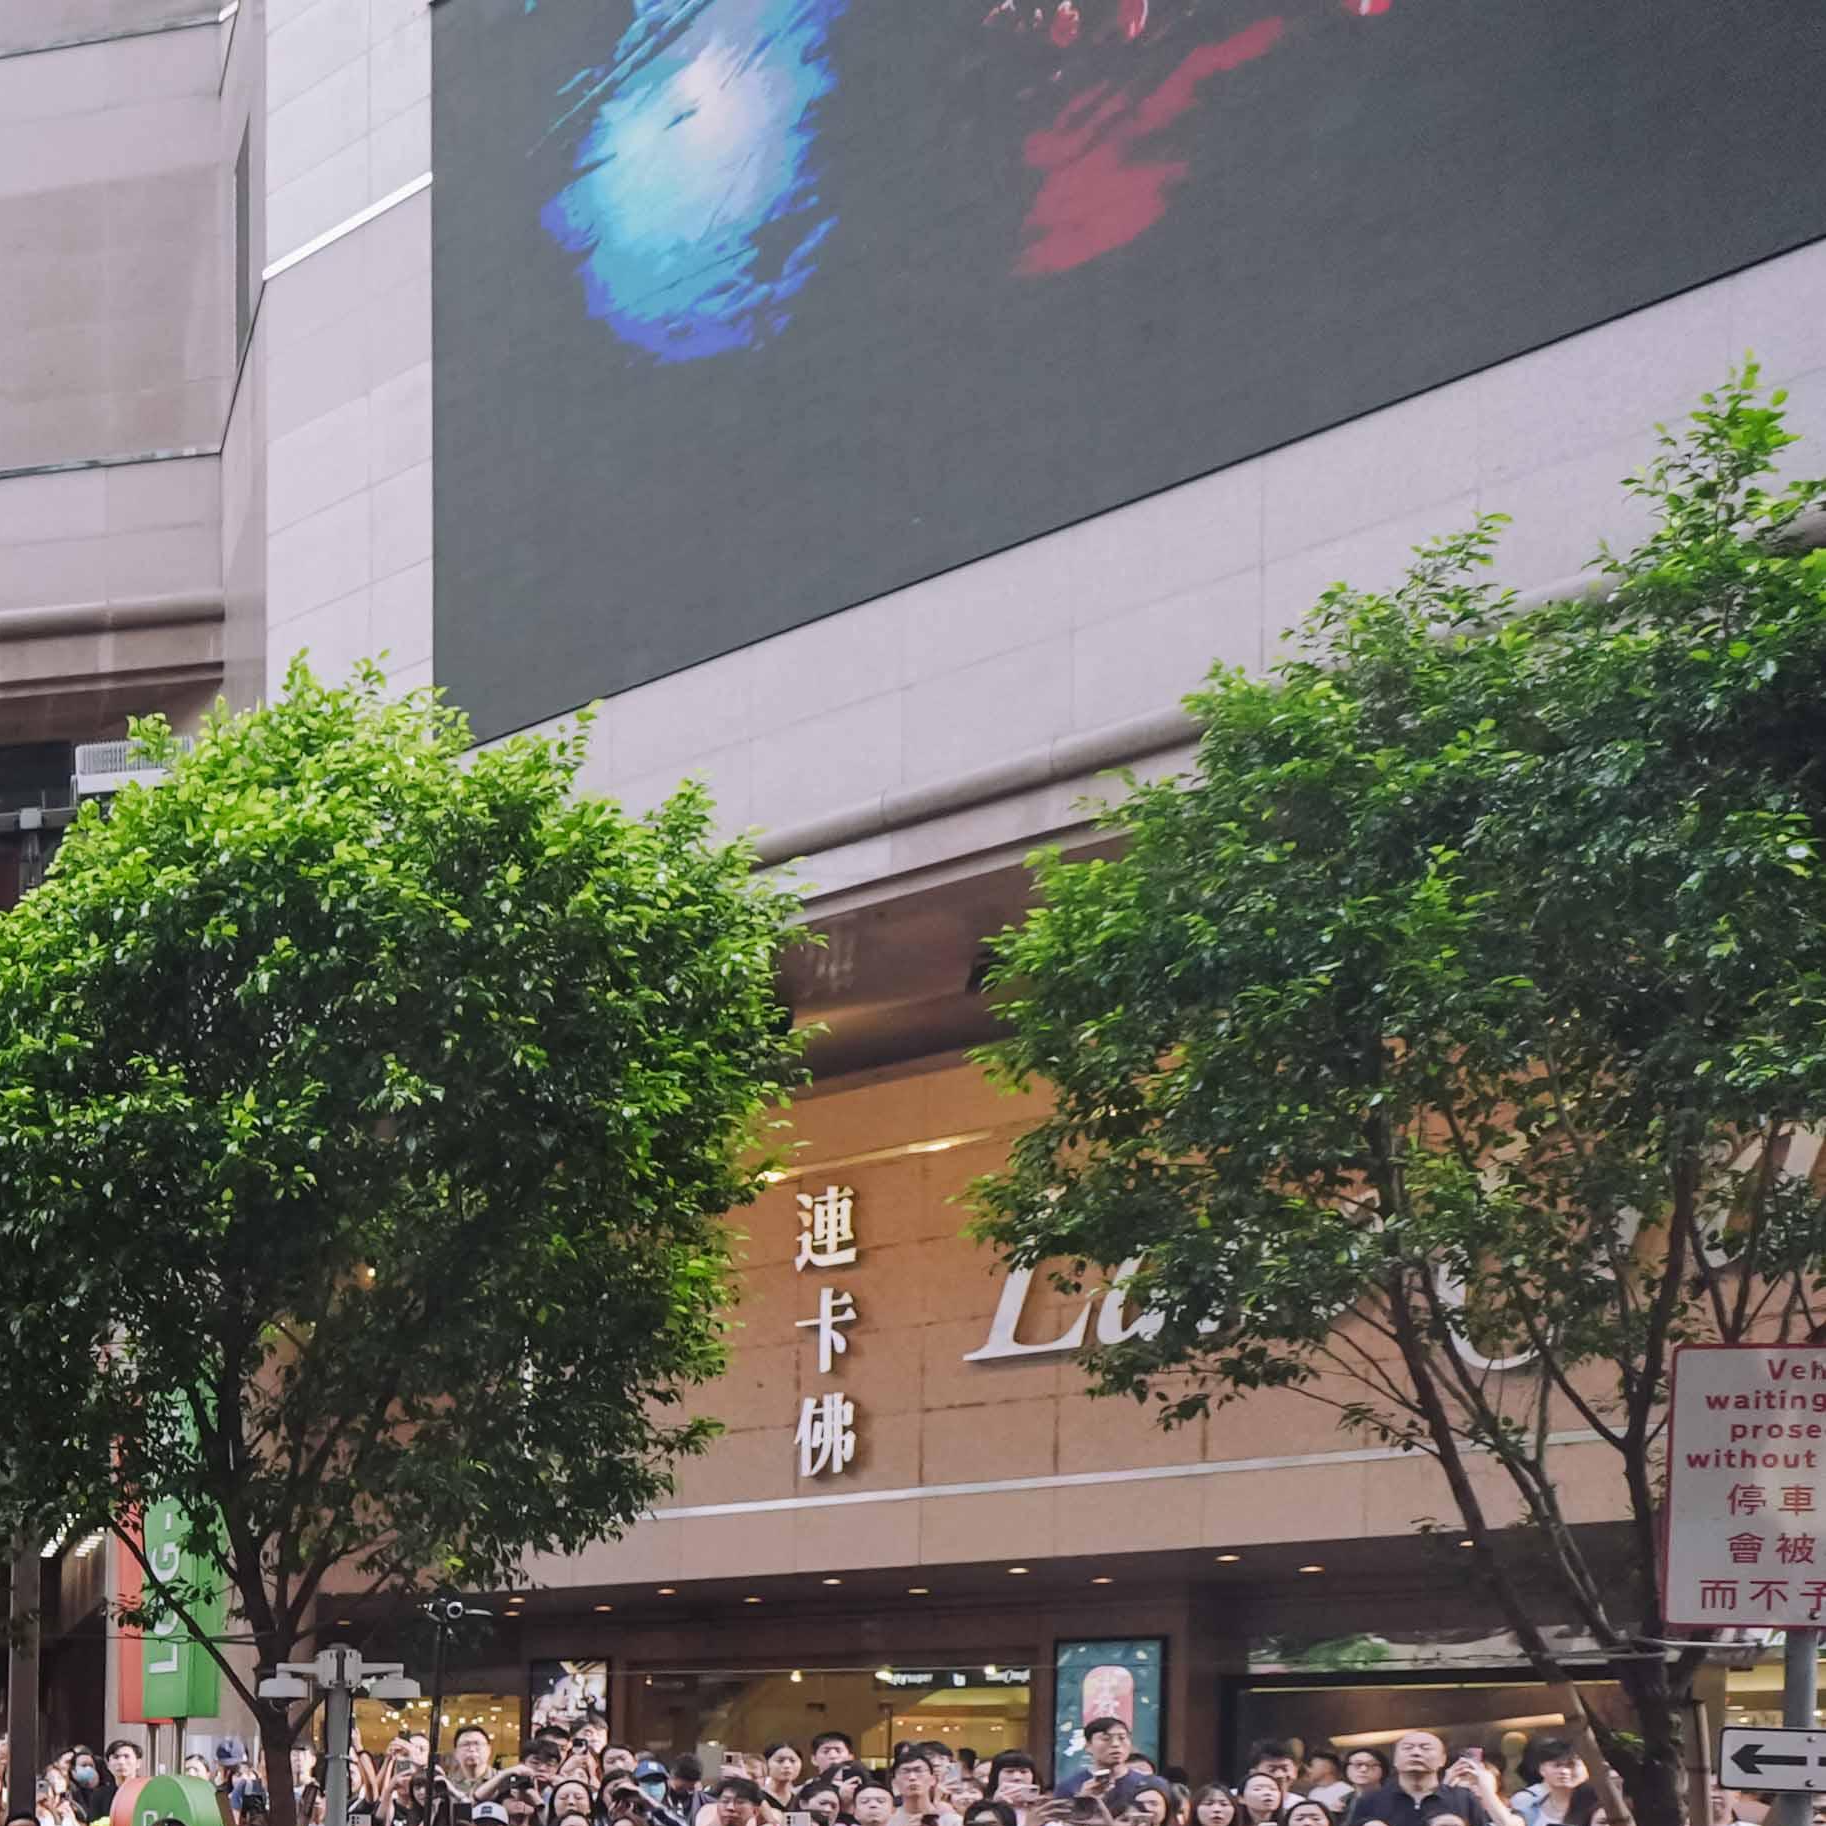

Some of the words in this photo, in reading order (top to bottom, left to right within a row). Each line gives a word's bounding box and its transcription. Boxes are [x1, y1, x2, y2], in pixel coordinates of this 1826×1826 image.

[794, 1185, 858, 1478] 連卡佛
[1705, 1389, 1826, 1413] waiting
[1730, 1423, 1826, 1442] prose
[1686, 1448, 1818, 1469] without
[1727, 1483, 1816, 1516] 停車
[1727, 1532, 1816, 1565] 會被
